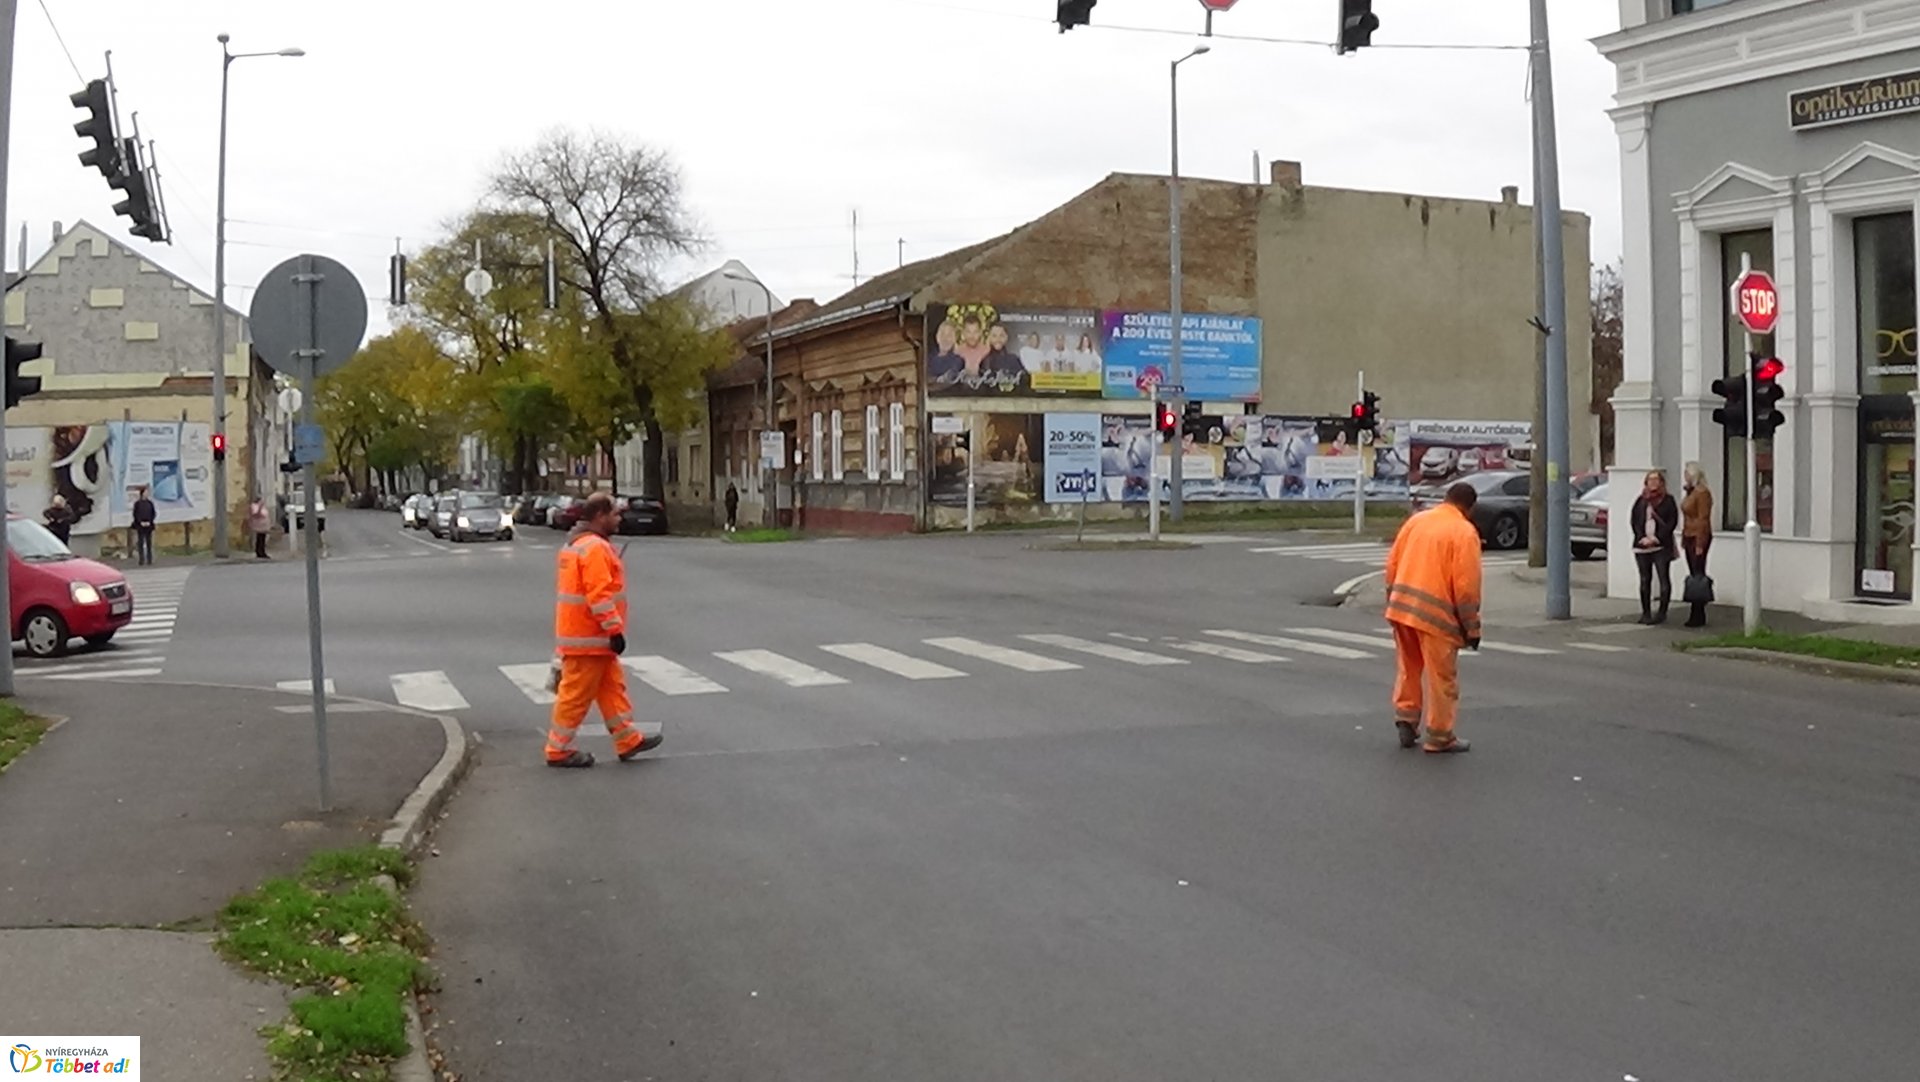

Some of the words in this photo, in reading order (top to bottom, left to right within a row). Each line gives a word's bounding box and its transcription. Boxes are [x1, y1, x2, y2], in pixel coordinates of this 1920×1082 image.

[1741, 289, 1775, 315] STOP
[1112, 327, 1121, 338] A
[1122, 328, 1145, 338] 200
[1147, 327, 1173, 340] ÉVES
[1180, 330, 1206, 342] RSTE
[1417, 423, 1470, 433] PRÉMIUM
